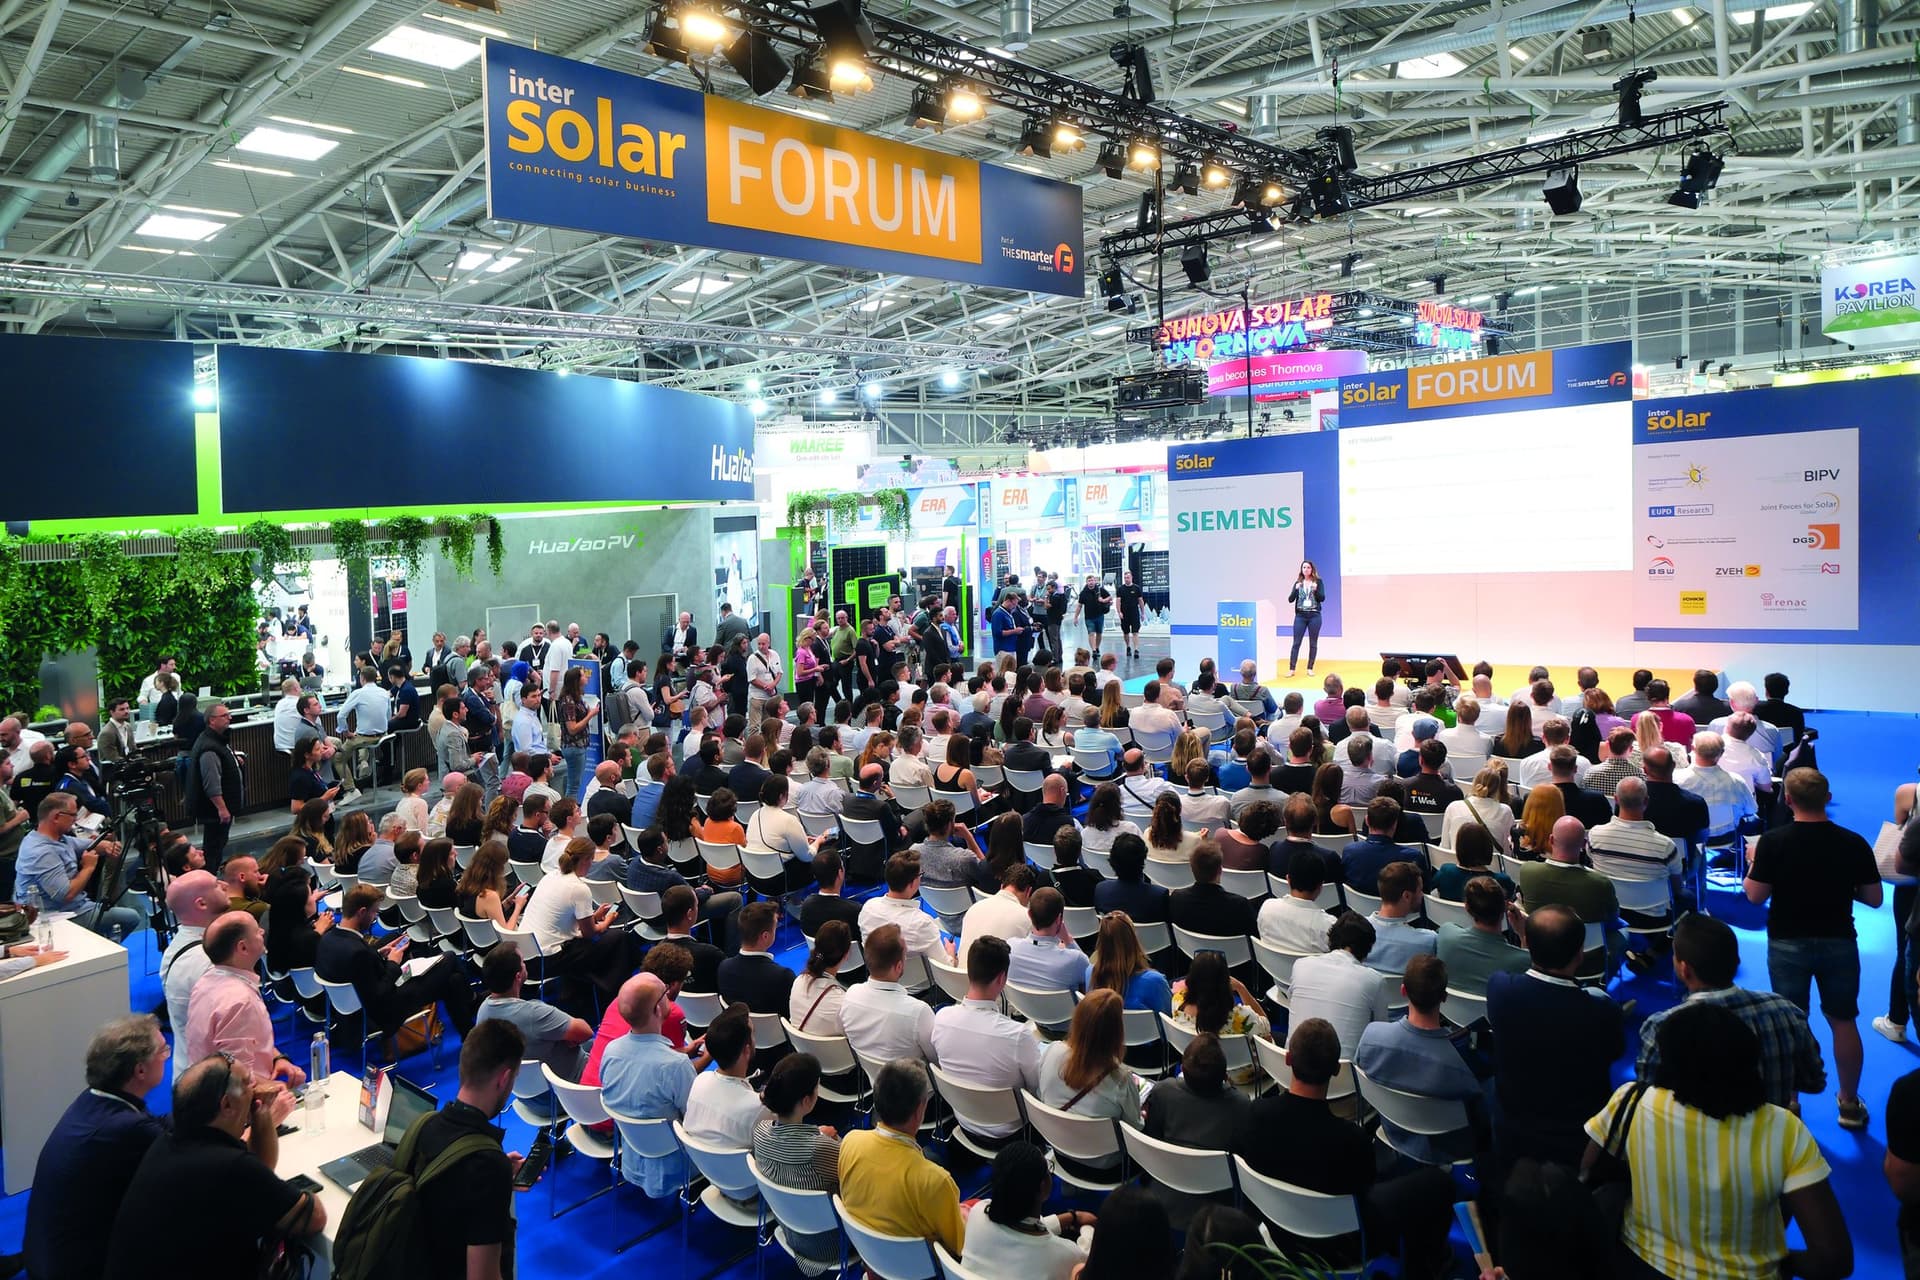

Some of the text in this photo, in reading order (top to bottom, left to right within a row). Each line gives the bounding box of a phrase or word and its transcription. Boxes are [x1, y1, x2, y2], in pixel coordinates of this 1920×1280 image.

[509, 69, 575, 105] inter
[506, 97, 686, 179] solar
[508, 161, 676, 198] connecting solar business
[728, 125, 957, 242] FORUM
[1835, 278, 1916, 301] KOREA
[1836, 293, 1915, 316] PAVILION
[1159, 294, 1333, 341] SUNOVA SOLAR
[1270, 363, 1324, 376] Thornova
[1343, 382, 1363, 390] inter
[1416, 361, 1536, 400] FORUM
[1343, 382, 1401, 404] solar
[1647, 409, 1711, 431] solar
[790, 437, 845, 453] WAAREE
[1176, 454, 1215, 470] solar
[1804, 469, 1840, 482] BIPV
[1003, 488, 1028, 506] ERA
[1085, 484, 1108, 500] ERA
[921, 498, 947, 512] ERA
[1815, 500, 1837, 508] Solar
[1177, 507, 1292, 532] SIEMENS
[1715, 567, 1743, 576] ZVEH
[1775, 598, 1807, 607] renac
[1220, 614, 1254, 627] solar
